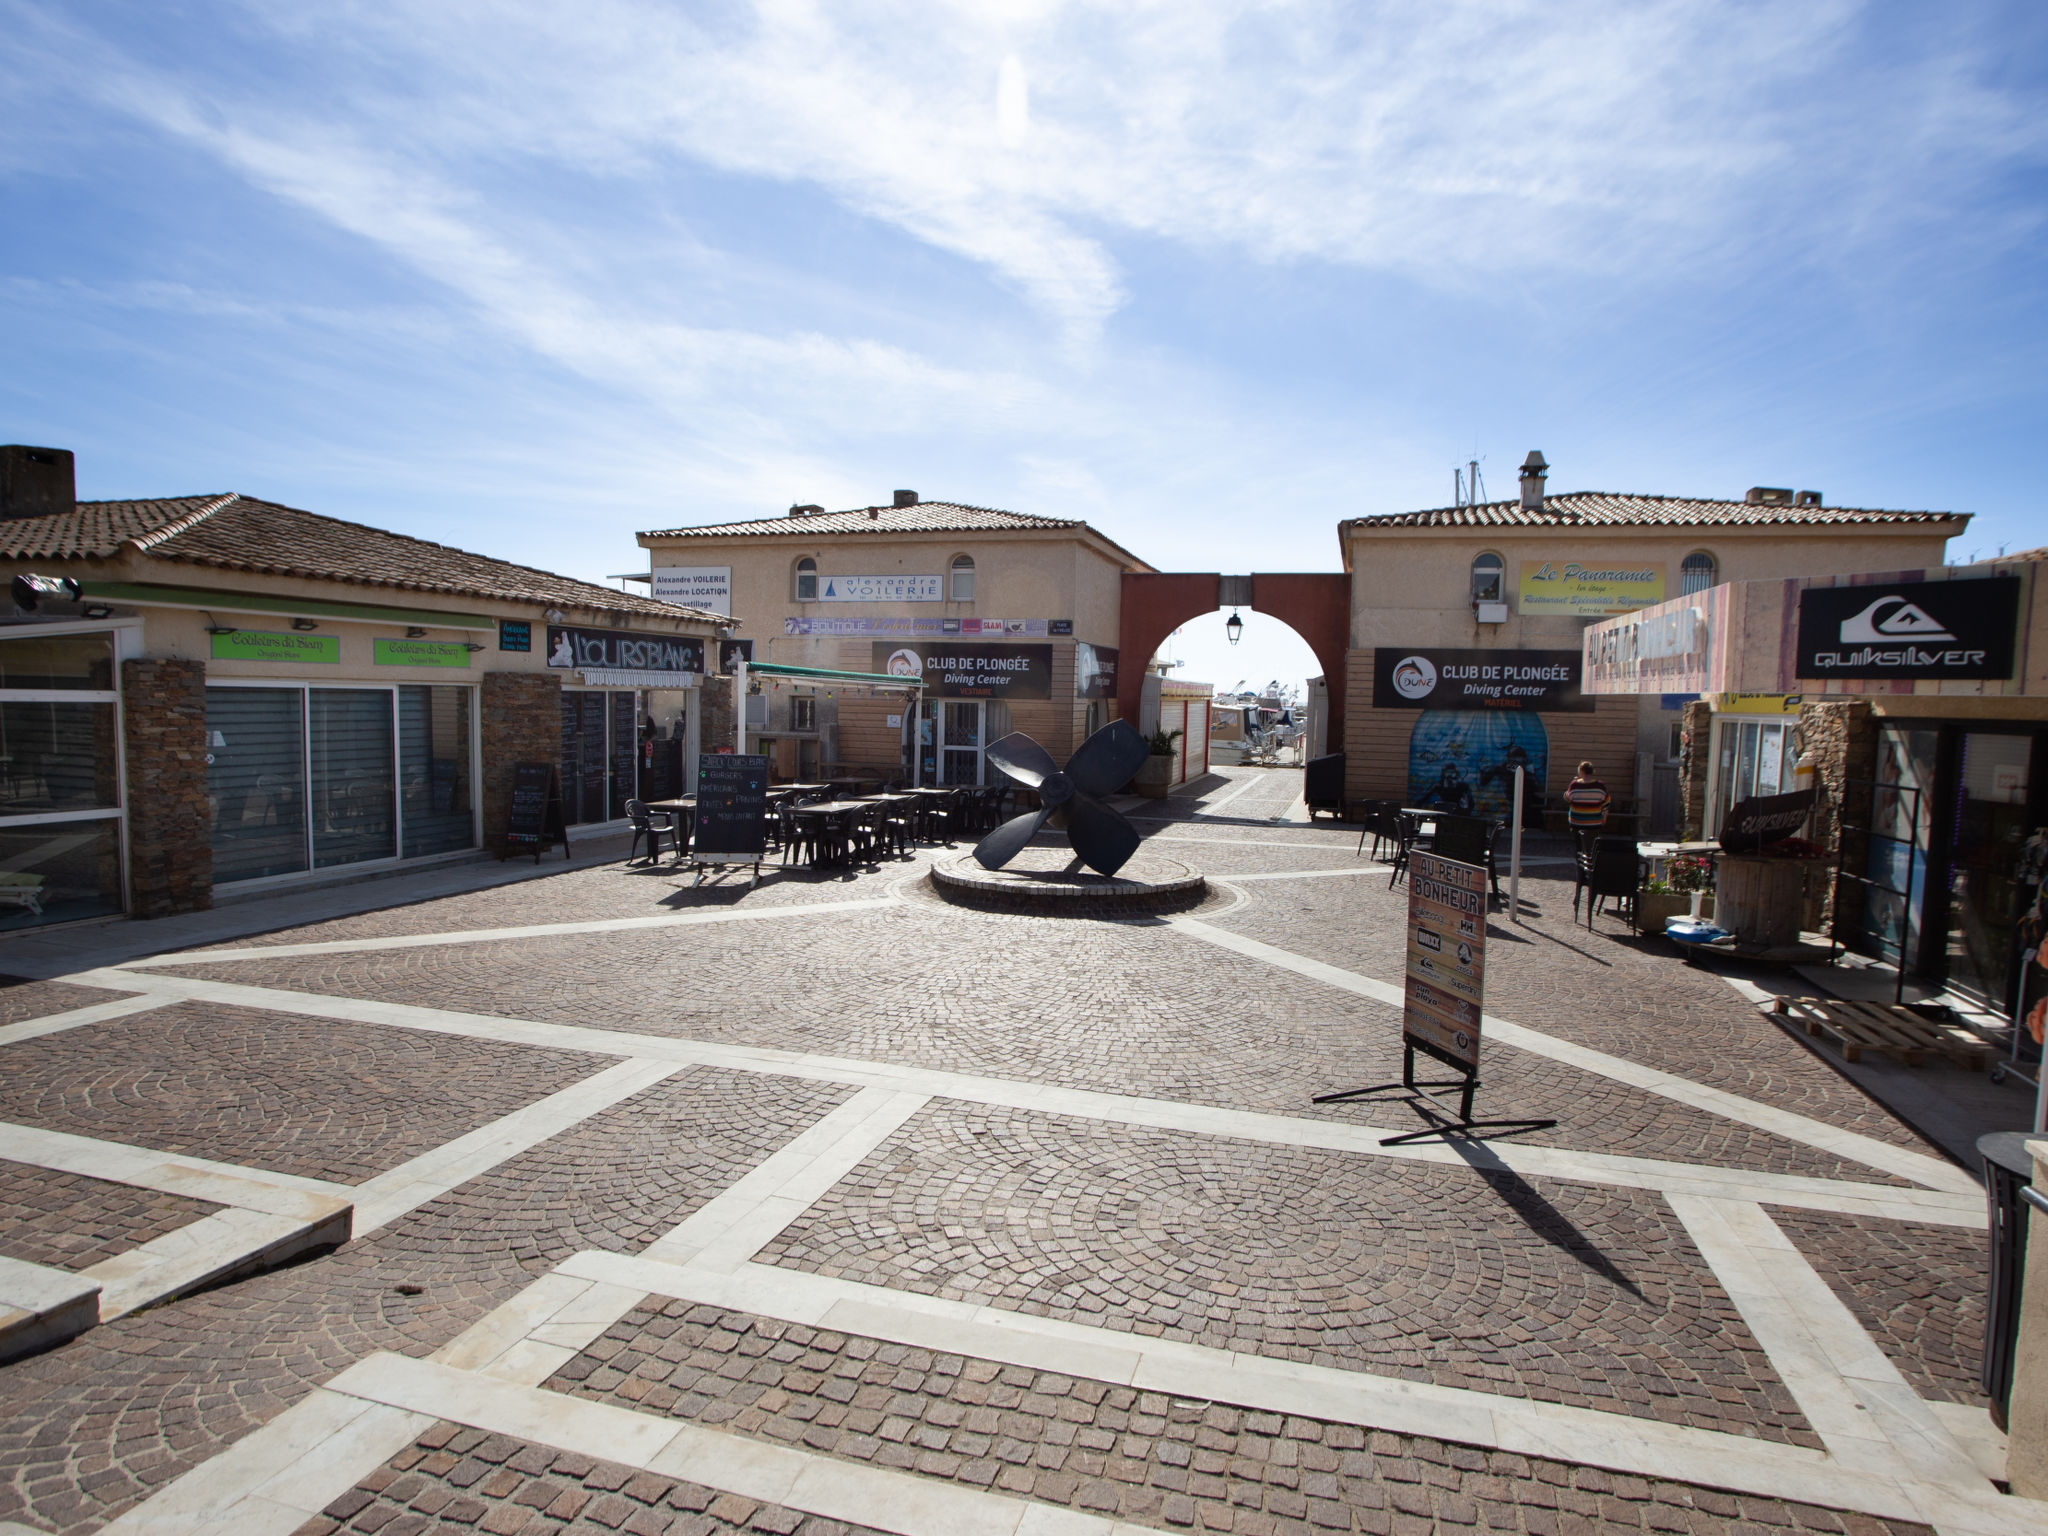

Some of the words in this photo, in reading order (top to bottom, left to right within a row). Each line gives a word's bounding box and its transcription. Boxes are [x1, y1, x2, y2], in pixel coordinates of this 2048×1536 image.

[692, 575, 726, 583] VOILERIE
[1531, 562, 1558, 581] Le
[1562, 563, 1656, 584] Panoramic
[846, 577, 936, 585] alexandre
[655, 588, 690, 596] Alexandre
[691, 588, 727, 596] LOCATION
[847, 586, 936, 595] VOILERIE
[811, 621, 866, 631] BOUTIQUE
[926, 657, 957, 670] CLUB
[958, 657, 974, 670] DE
[976, 655, 1030, 671] PLONGÉE
[1442, 665, 1479, 679] CLUB
[1481, 665, 1501, 680] DE
[1503, 664, 1570, 681] PLONGÉE
[944, 673, 975, 686] Diving
[977, 674, 1011, 685] Center
[1403, 677, 1434, 688] DUNE
[960, 687, 993, 696] VESTIAIRE
[1463, 684, 1502, 697] Diving
[1504, 684, 1546, 696] Center
[1420, 857, 1435, 876] AU
[1439, 861, 1473, 889] PETIT
[1415, 876, 1479, 916] BONHEUR
[1416, 984, 1430, 995] sun
[1450, 977, 1478, 997] Superdry
